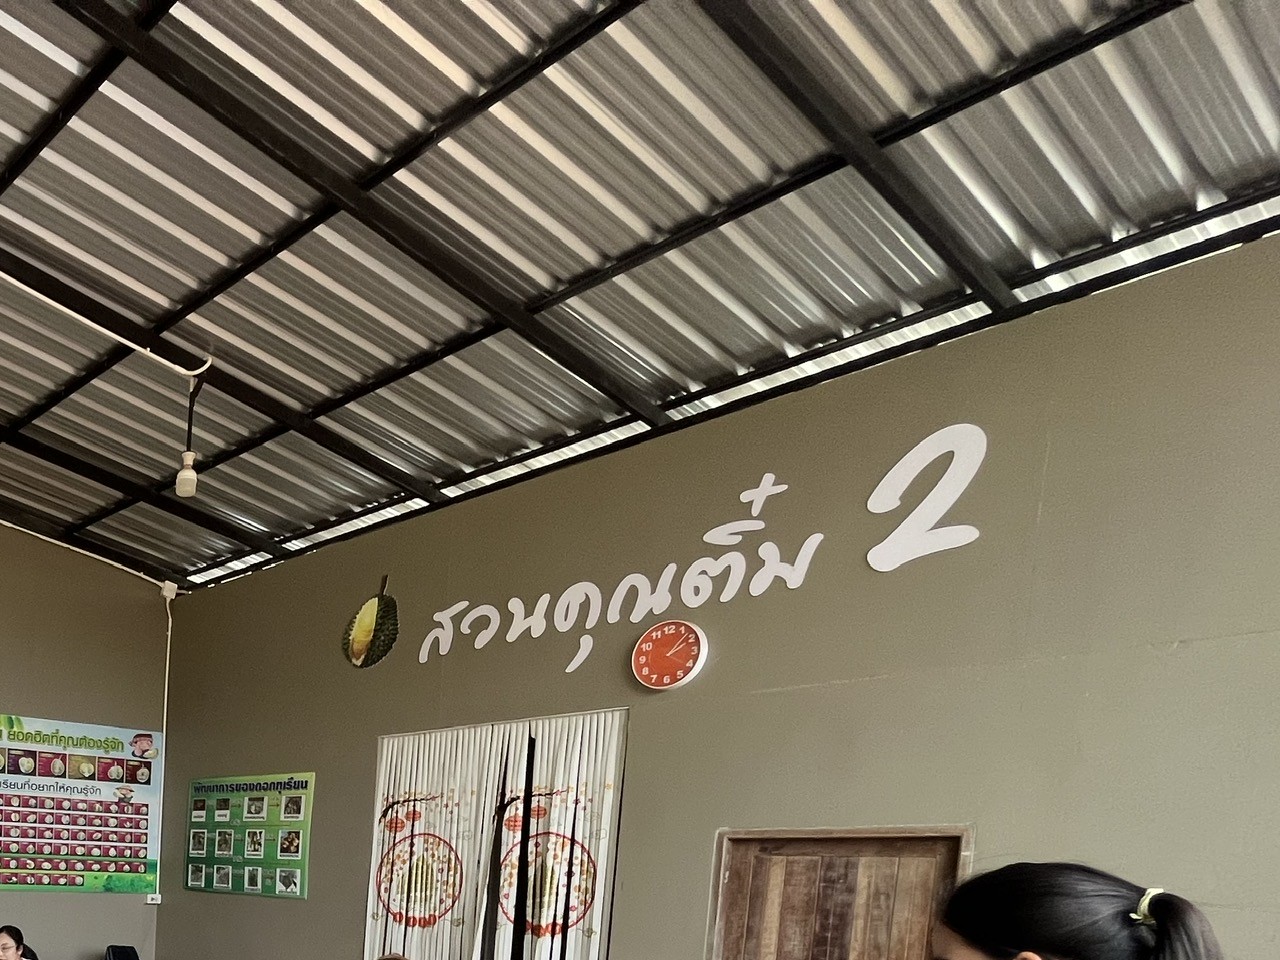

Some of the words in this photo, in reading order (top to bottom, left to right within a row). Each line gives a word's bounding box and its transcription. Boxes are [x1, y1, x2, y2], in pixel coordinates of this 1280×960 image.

[865, 423, 987, 572] 2
[663, 625, 676, 634] 12
[679, 626, 685, 634] 1
[651, 630, 662, 639] 11
[688, 634, 695, 642] 2
[641, 642, 652, 651] 10
[691, 646, 698, 654] 3
[639, 656, 646, 664] 9
[686, 659, 693, 667] 4
[642, 667, 648, 675] 8
[677, 670, 684, 678] 5
[650, 674, 657, 683] 7
